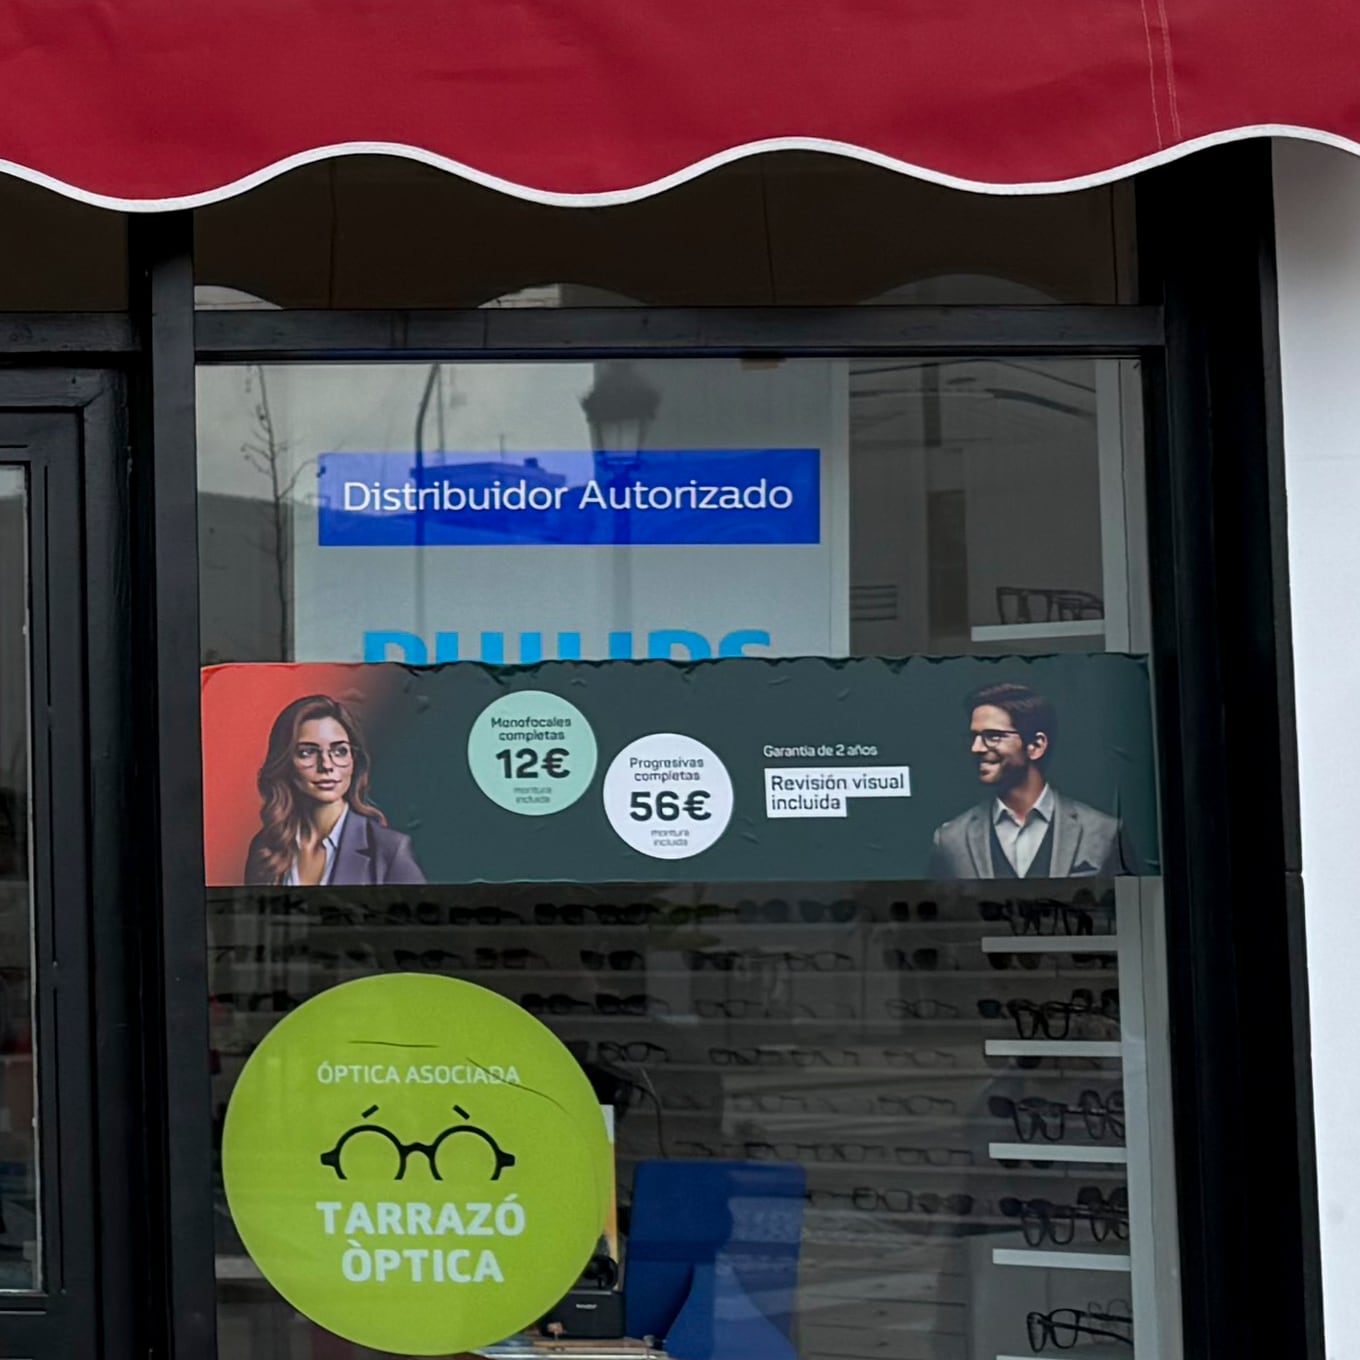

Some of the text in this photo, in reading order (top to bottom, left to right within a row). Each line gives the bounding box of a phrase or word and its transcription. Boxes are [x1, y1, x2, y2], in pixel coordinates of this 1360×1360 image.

[344, 479, 793, 512] Distribuidor Autorizado
[491, 717, 571, 728] Monofocales
[499, 730, 565, 742] completas
[817, 745, 833, 757] de
[835, 744, 845, 756] 2
[847, 745, 878, 757] años
[496, 748, 570, 779] 12€
[630, 757, 704, 771] Progresivas
[634, 771, 701, 782] completas
[771, 772, 904, 791] Revisión visual
[630, 790, 712, 822] 56€
[771, 795, 841, 811] incluida
[317, 1060, 520, 1085] ÓPTICA ASOCIADA
[316, 1194, 526, 1236] TARRAZÓ
[341, 1240, 504, 1284] ÒPTICA
